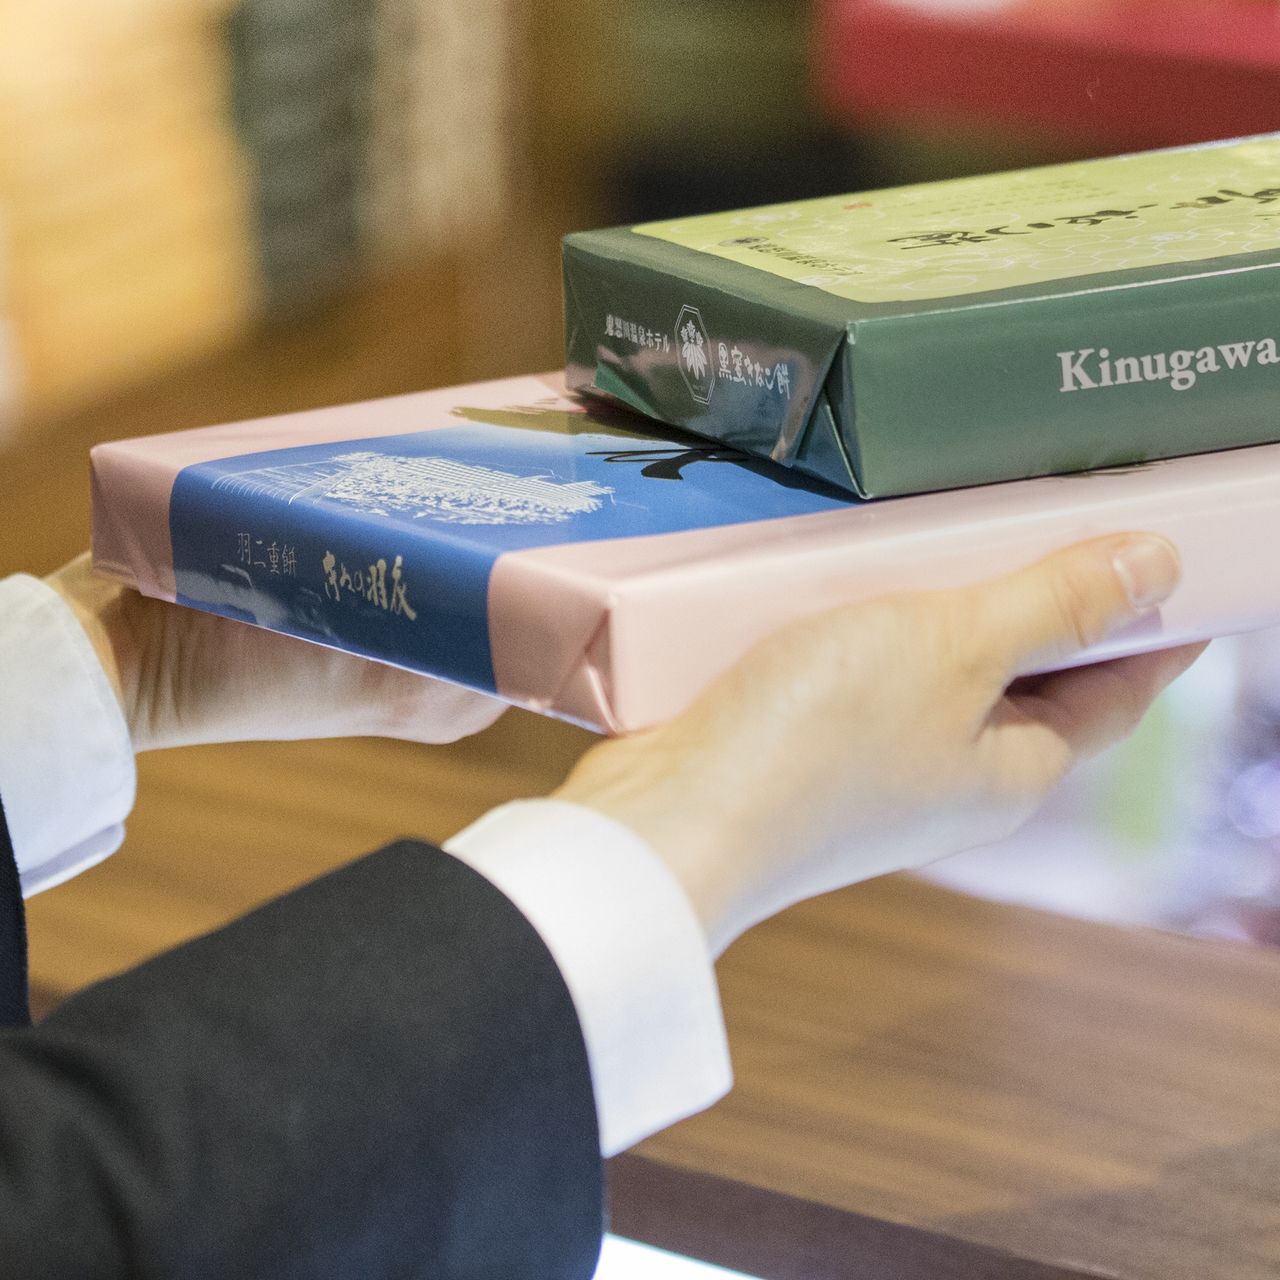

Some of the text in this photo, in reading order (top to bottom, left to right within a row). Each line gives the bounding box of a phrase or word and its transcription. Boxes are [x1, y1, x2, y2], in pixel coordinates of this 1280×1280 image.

[604, 313, 671, 354] 鬼怒川温泉ホテル
[237, 532, 298, 577] 羽二重餅
